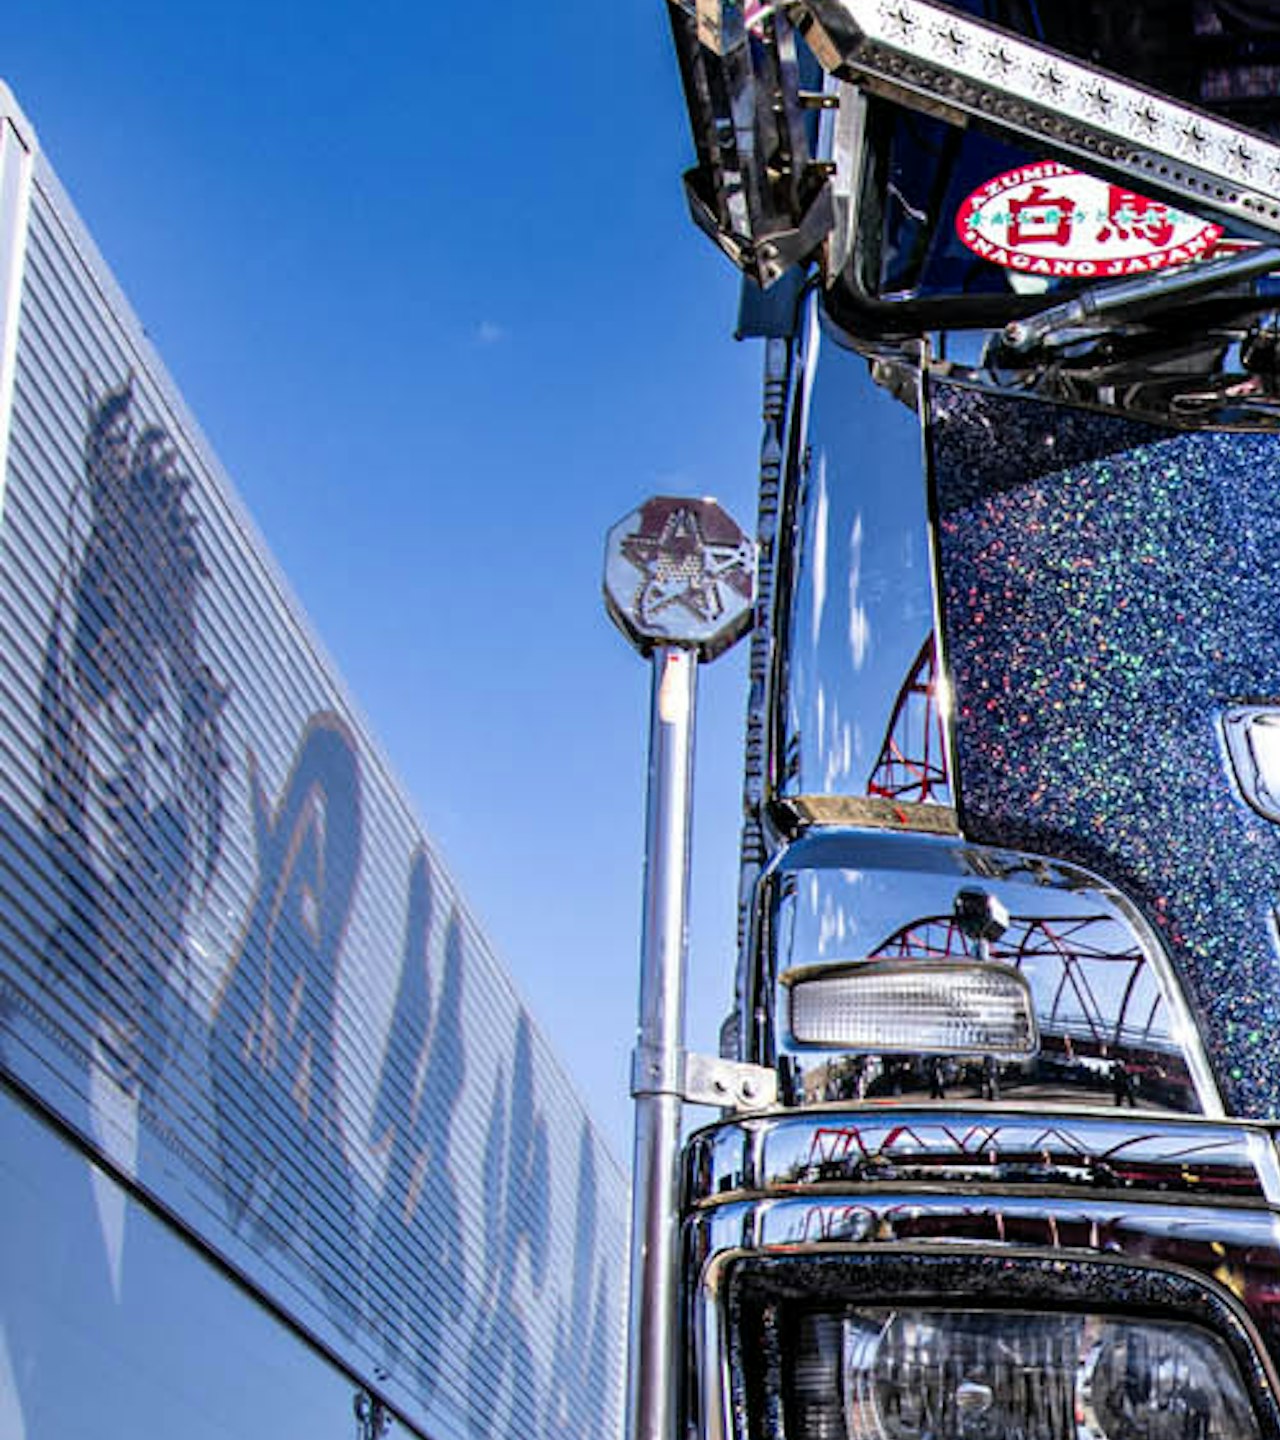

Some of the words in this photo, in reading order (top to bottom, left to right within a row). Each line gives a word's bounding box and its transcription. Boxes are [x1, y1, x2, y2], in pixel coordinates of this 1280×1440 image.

[1007, 184, 1175, 248] 白馬
[972, 239, 1098, 275] NAGANO
[1107, 237, 1208, 275] JAPAN
